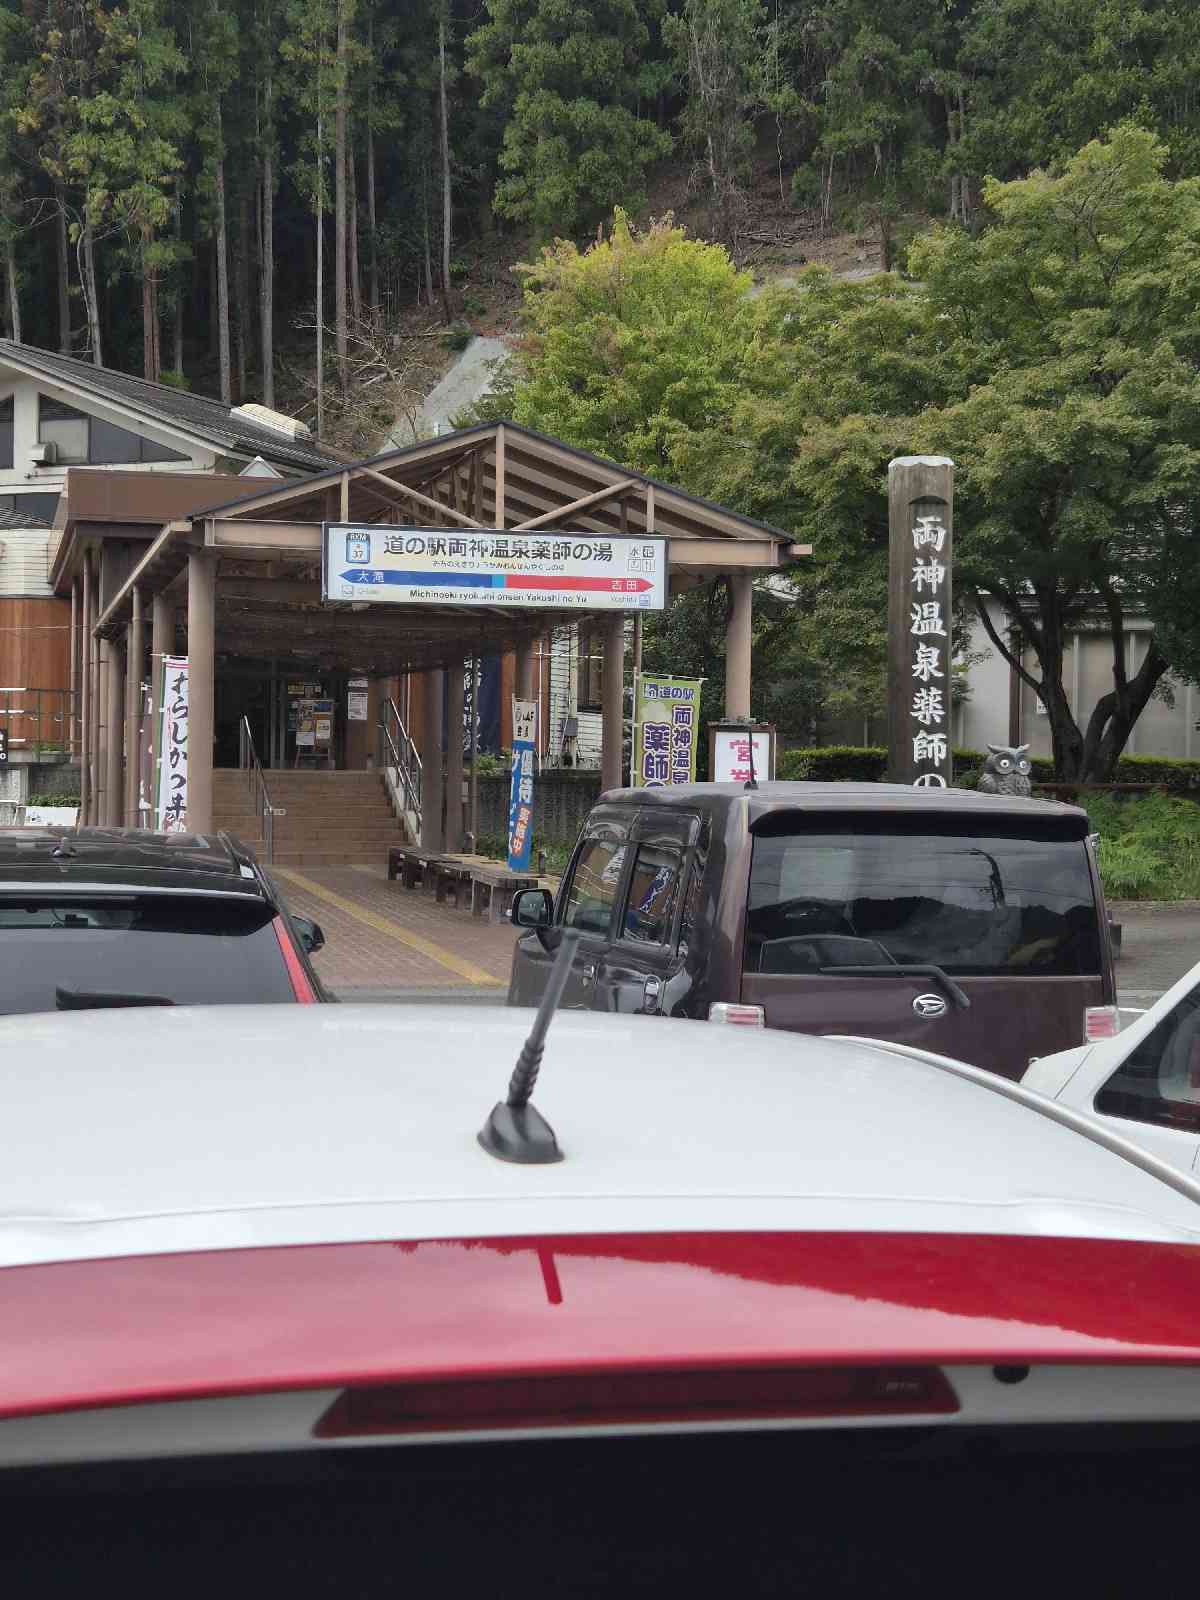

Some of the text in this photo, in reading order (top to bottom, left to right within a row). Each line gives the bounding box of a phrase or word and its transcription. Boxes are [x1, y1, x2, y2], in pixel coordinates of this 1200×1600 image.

[383, 534, 613, 562] 道の駅両神温泉薬師の湯
[611, 579, 637, 591] 吉田
[659, 685, 695, 700] 道の駅
